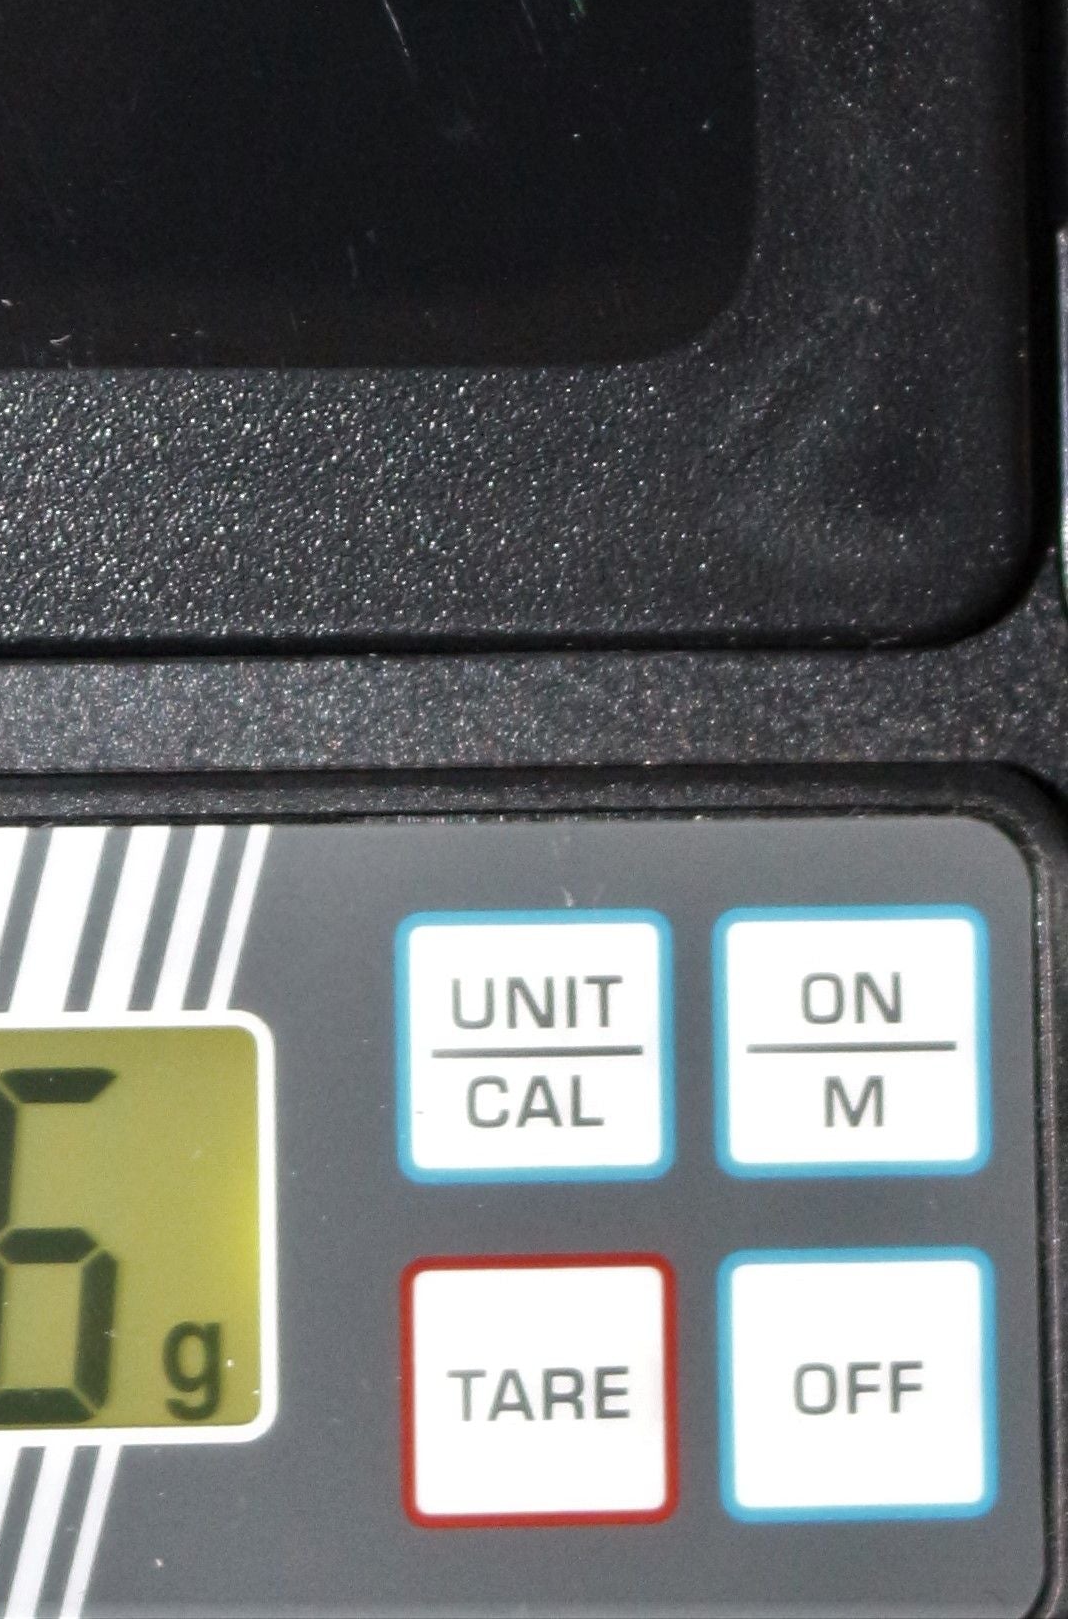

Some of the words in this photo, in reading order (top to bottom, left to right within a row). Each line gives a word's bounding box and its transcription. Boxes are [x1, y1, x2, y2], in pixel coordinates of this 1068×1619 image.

[450, 974, 623, 1030] UNIT
[801, 970, 903, 1025] ON
[465, 1073, 605, 1128] CAL
[824, 1074, 885, 1127] M
[161, 1319, 223, 1421] g
[447, 1365, 631, 1422] TARE
[793, 1360, 924, 1416] OFF
